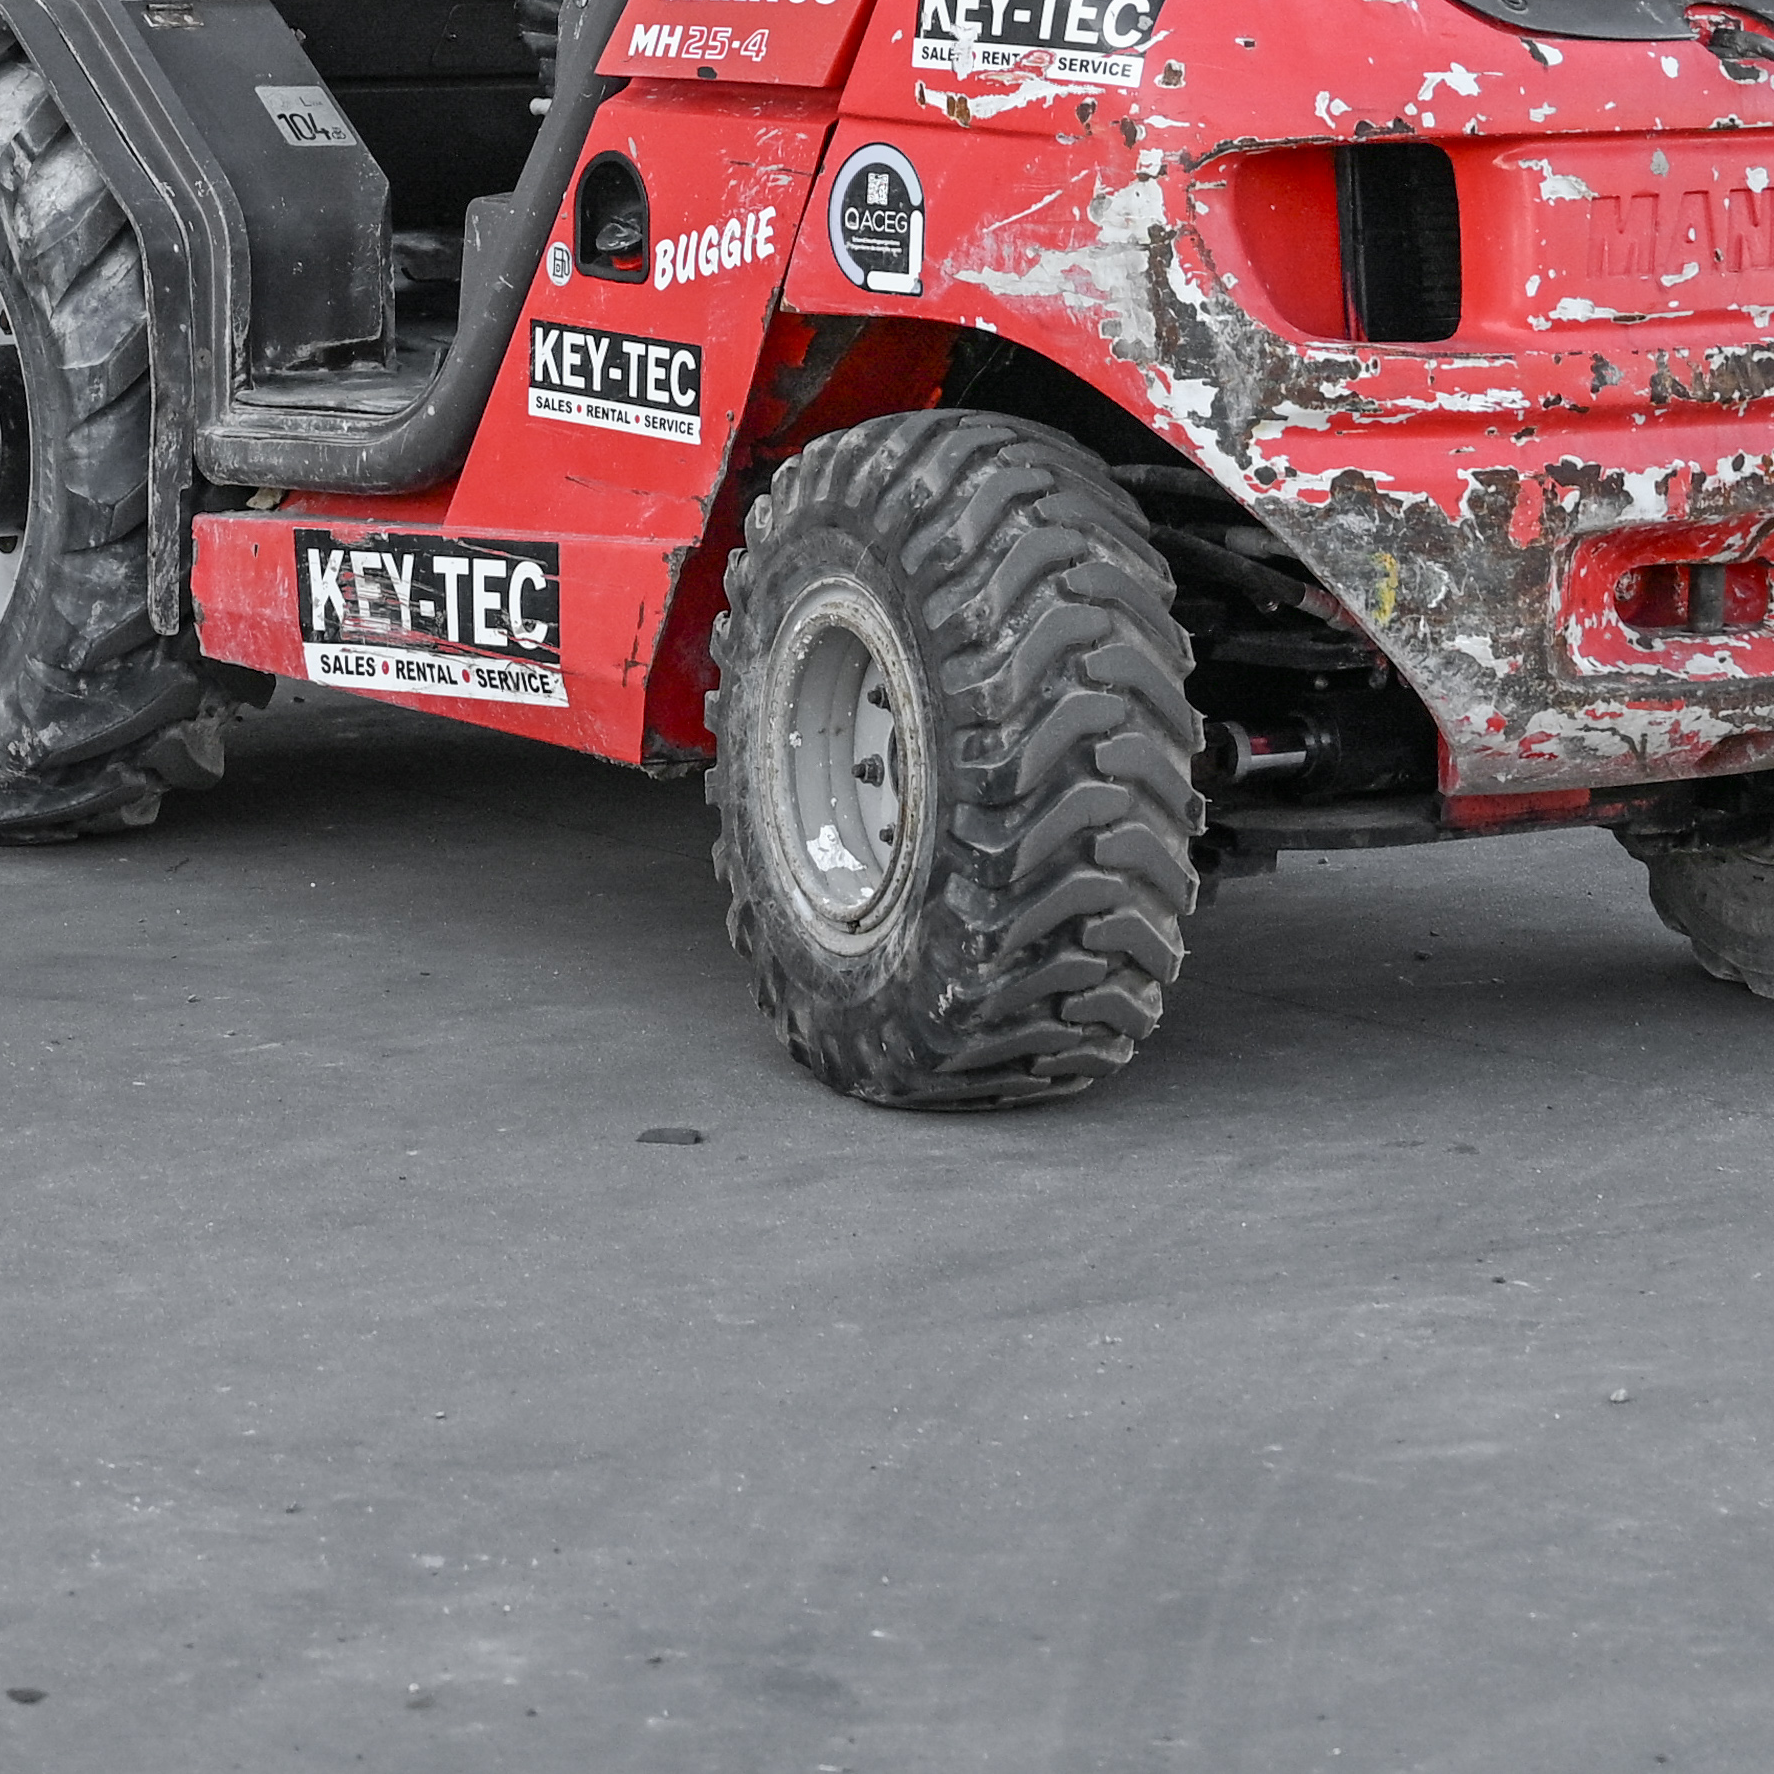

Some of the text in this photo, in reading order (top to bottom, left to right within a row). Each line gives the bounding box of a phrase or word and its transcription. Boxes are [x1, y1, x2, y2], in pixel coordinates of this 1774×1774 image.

[1057, 56, 1133, 78] SERVICE
[277, 112, 332, 141] 104
[653, 205, 777, 291] BUGGIE
[534, 325, 697, 408] KEY-TEC
[535, 395, 695, 436] SALES RENTAL SERVICE
[307, 547, 548, 650] KEY-TEC
[320, 654, 553, 694] SALES RENTAL SERVICE
